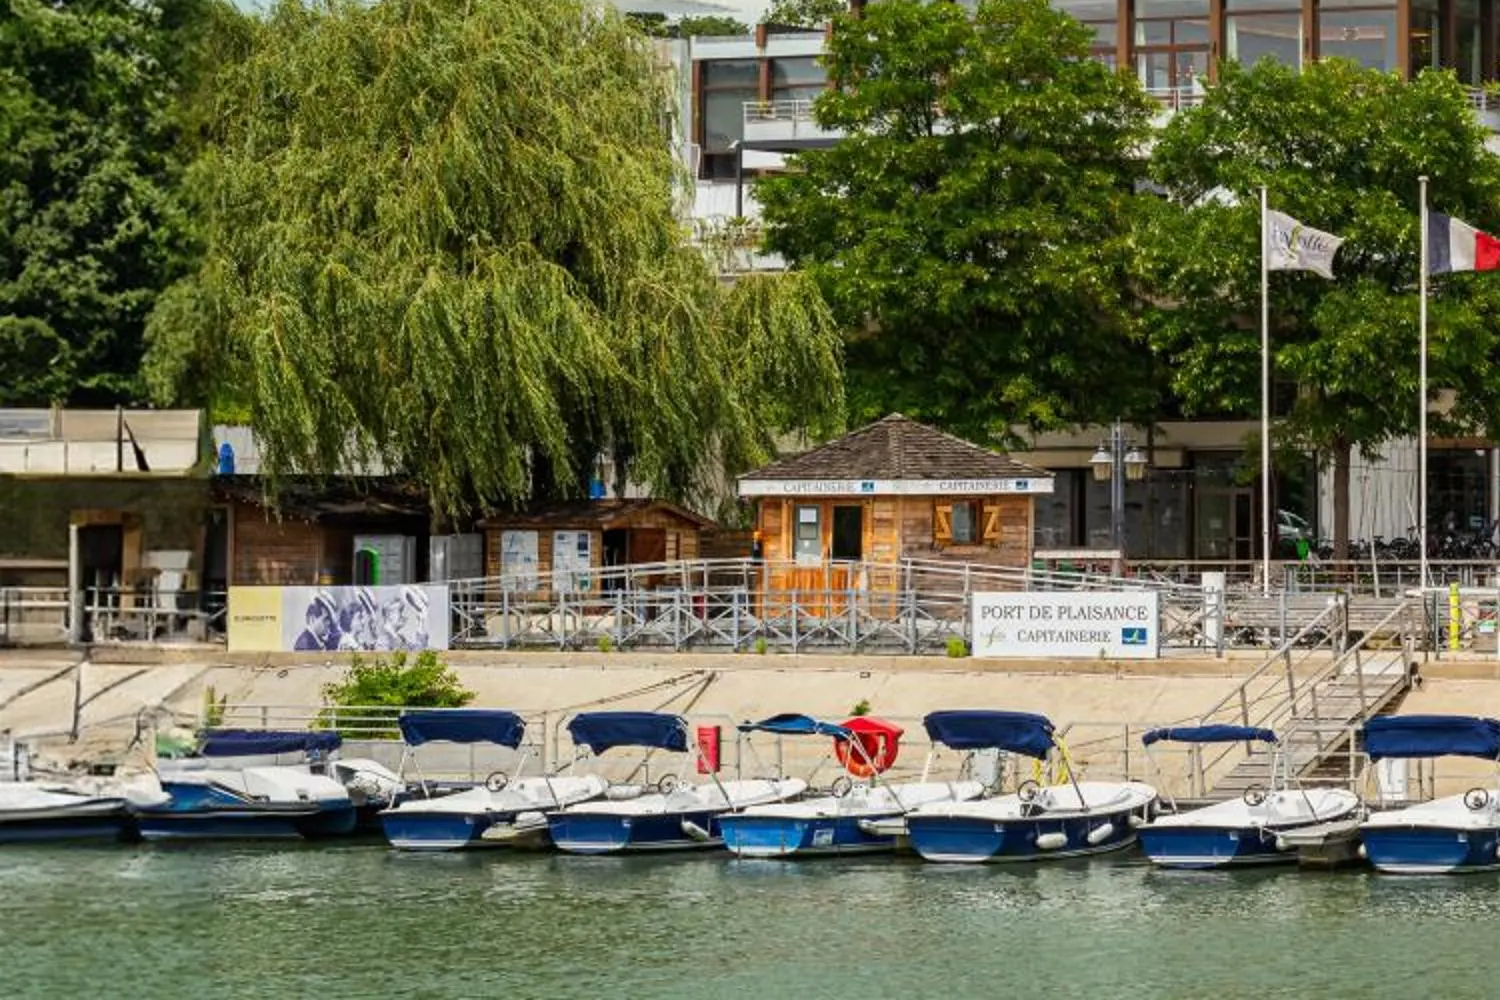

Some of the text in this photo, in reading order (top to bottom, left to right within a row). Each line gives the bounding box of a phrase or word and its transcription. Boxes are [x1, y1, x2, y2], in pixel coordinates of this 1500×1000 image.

[981, 605, 1148, 621] PORT DE PLAISANCE
[1017, 629, 1111, 643] CAPITAINERIE
